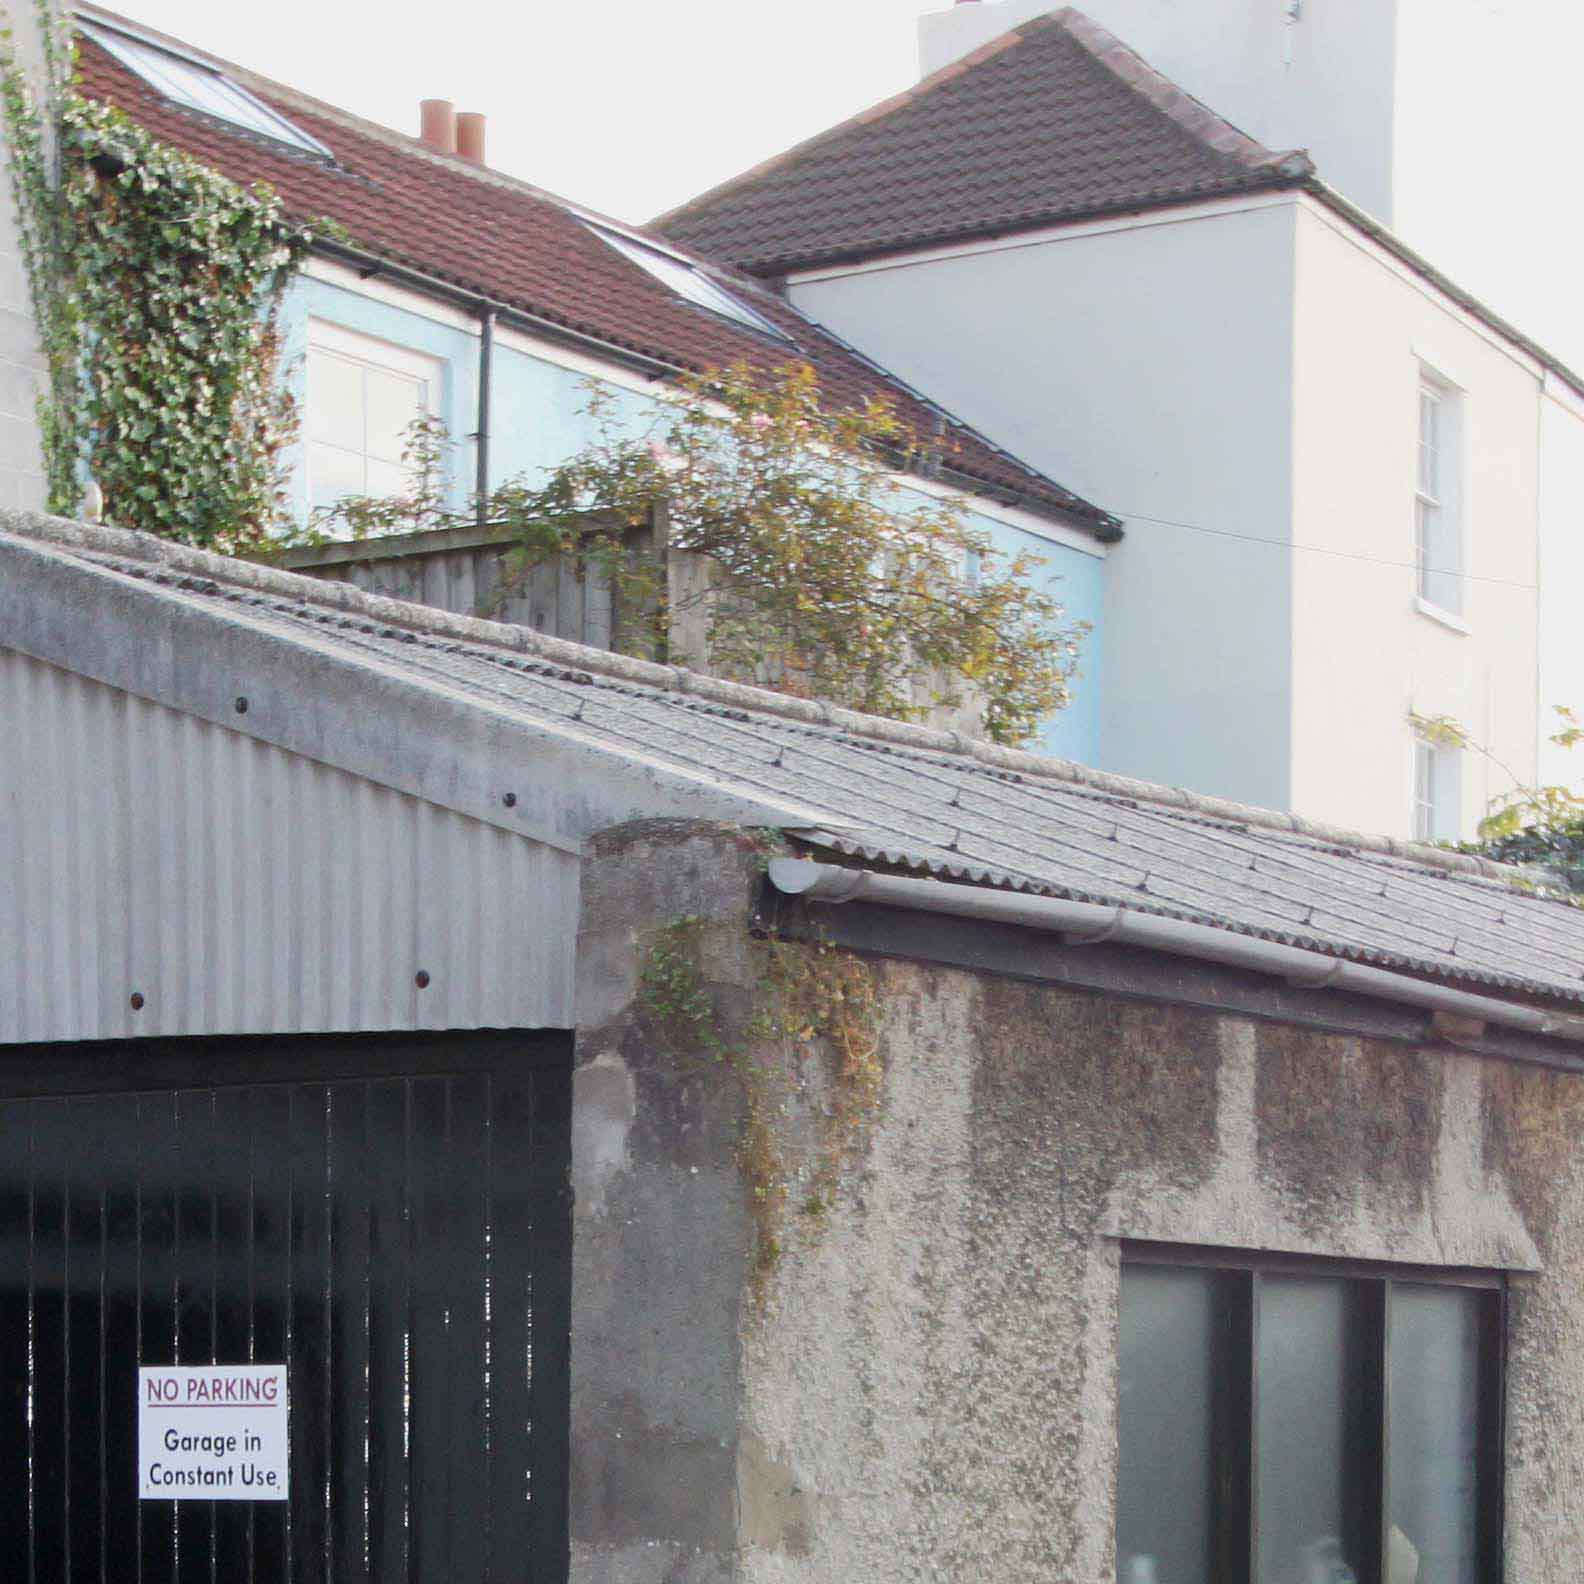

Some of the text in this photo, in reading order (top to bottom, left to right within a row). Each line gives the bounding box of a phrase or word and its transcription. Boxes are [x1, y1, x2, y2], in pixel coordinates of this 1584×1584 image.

[147, 1376, 278, 1401] NO PARKING
[164, 1428, 262, 1457] Garage in
[149, 1462, 277, 1486] Constant Use
